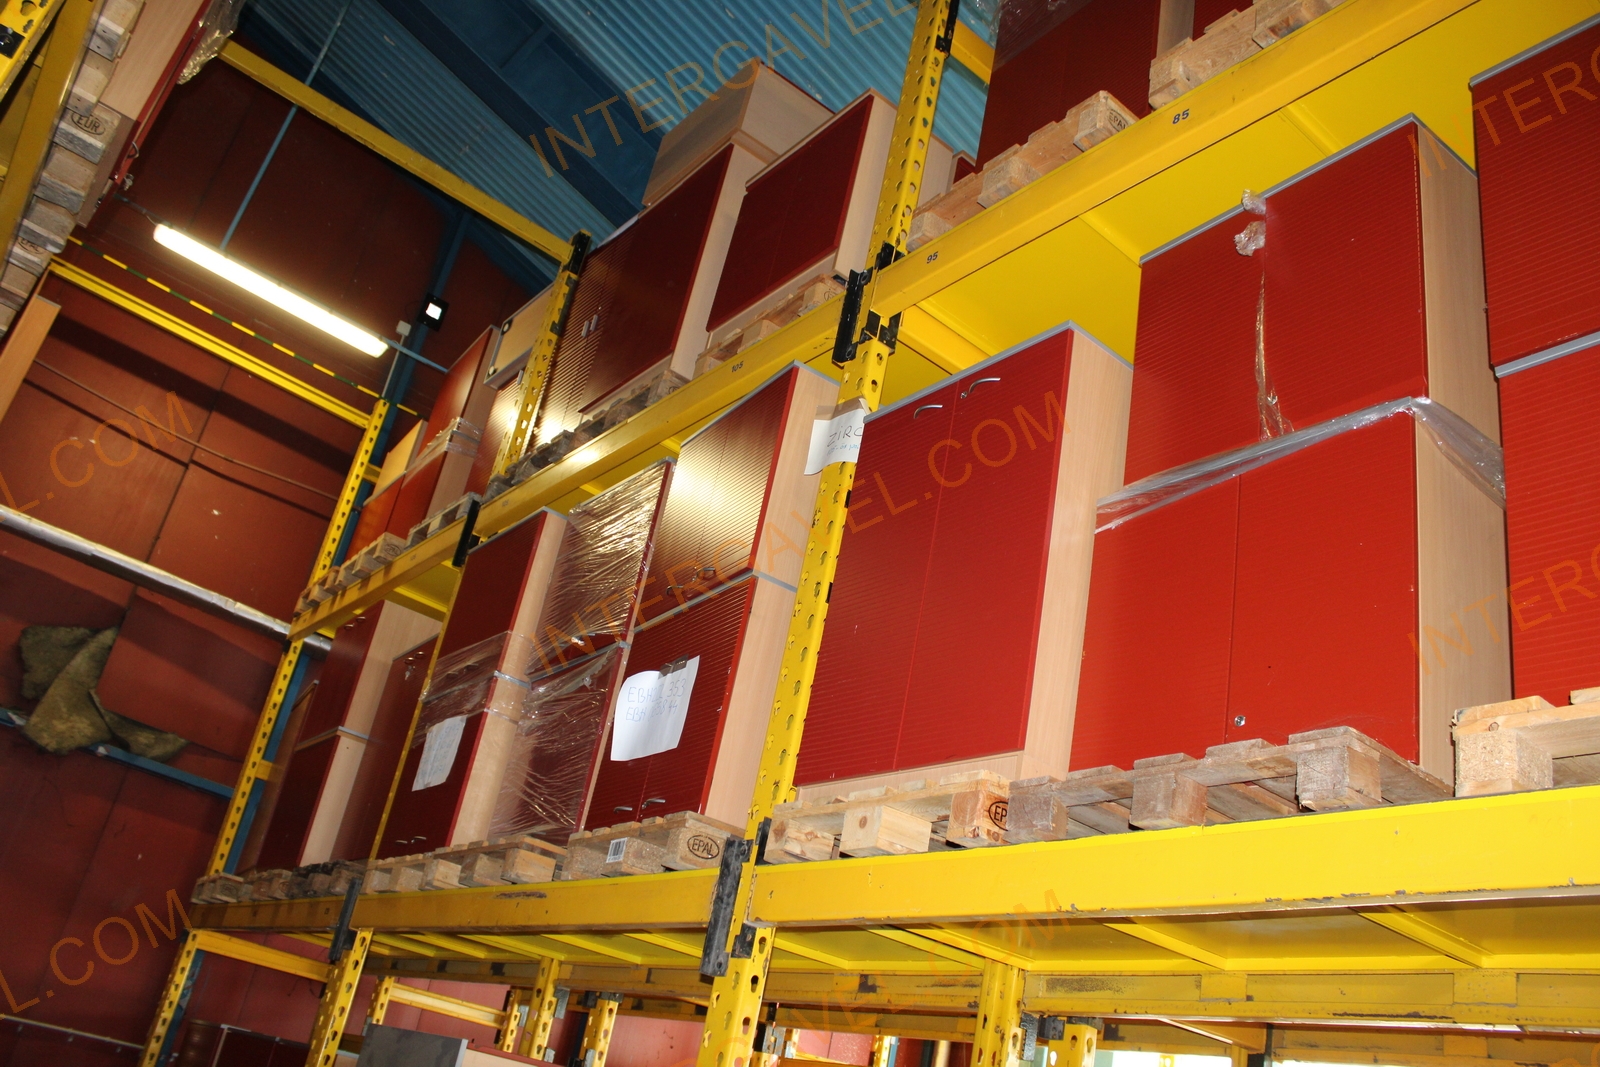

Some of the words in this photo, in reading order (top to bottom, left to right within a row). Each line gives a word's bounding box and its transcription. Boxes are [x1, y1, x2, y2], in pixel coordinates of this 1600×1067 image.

[1172, 108, 1190, 125] 85
[926, 250, 939, 264] 95
[666, 678, 687, 698] 353
[691, 838, 714, 857] EPAL
